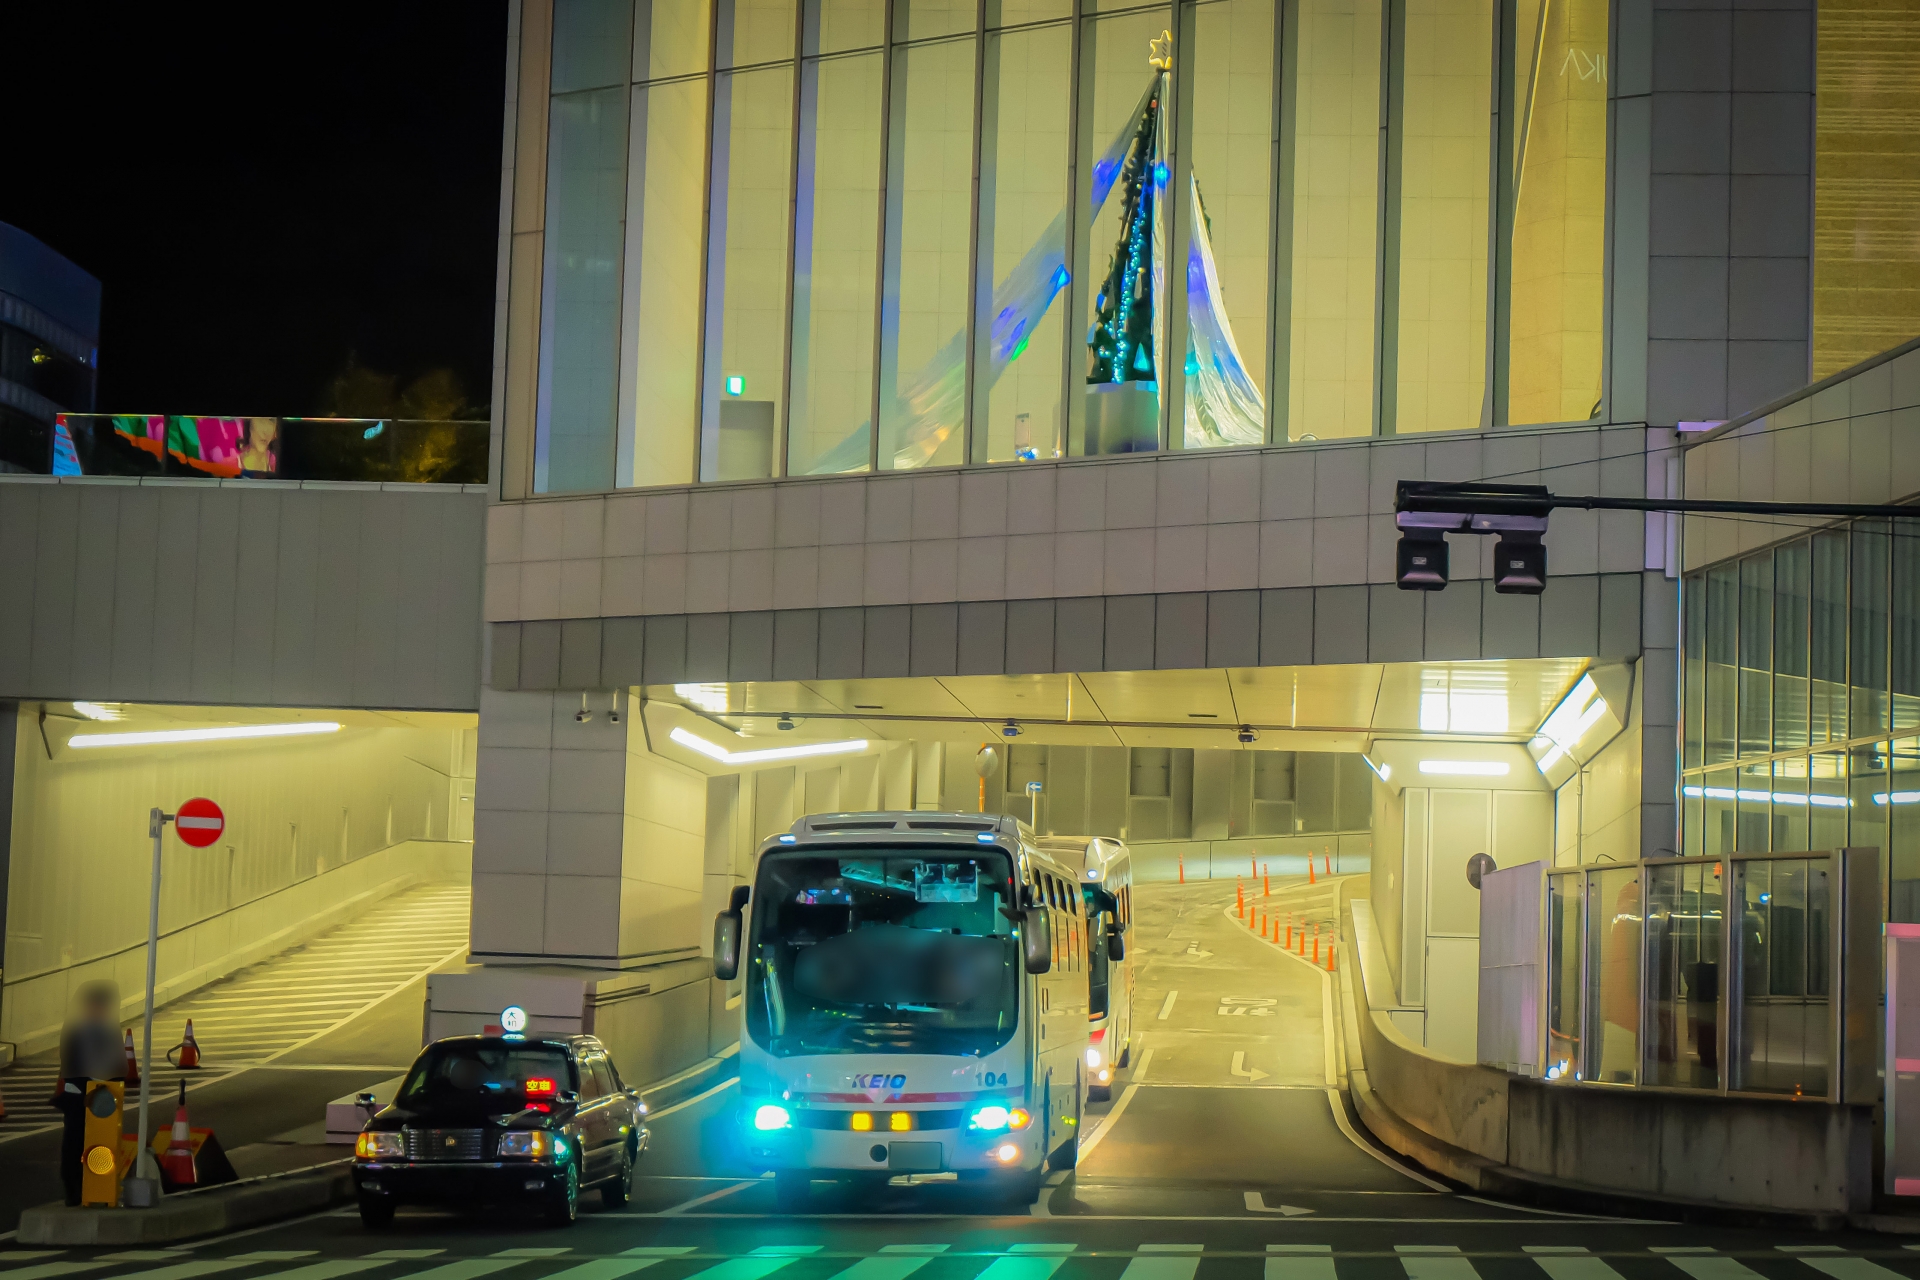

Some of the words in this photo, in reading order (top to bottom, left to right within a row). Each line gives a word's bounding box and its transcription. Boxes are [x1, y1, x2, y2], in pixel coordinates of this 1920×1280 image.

[526, 1079, 551, 1092] 空車
[852, 1073, 907, 1089] KEIO
[975, 1072, 1008, 1088] 104
